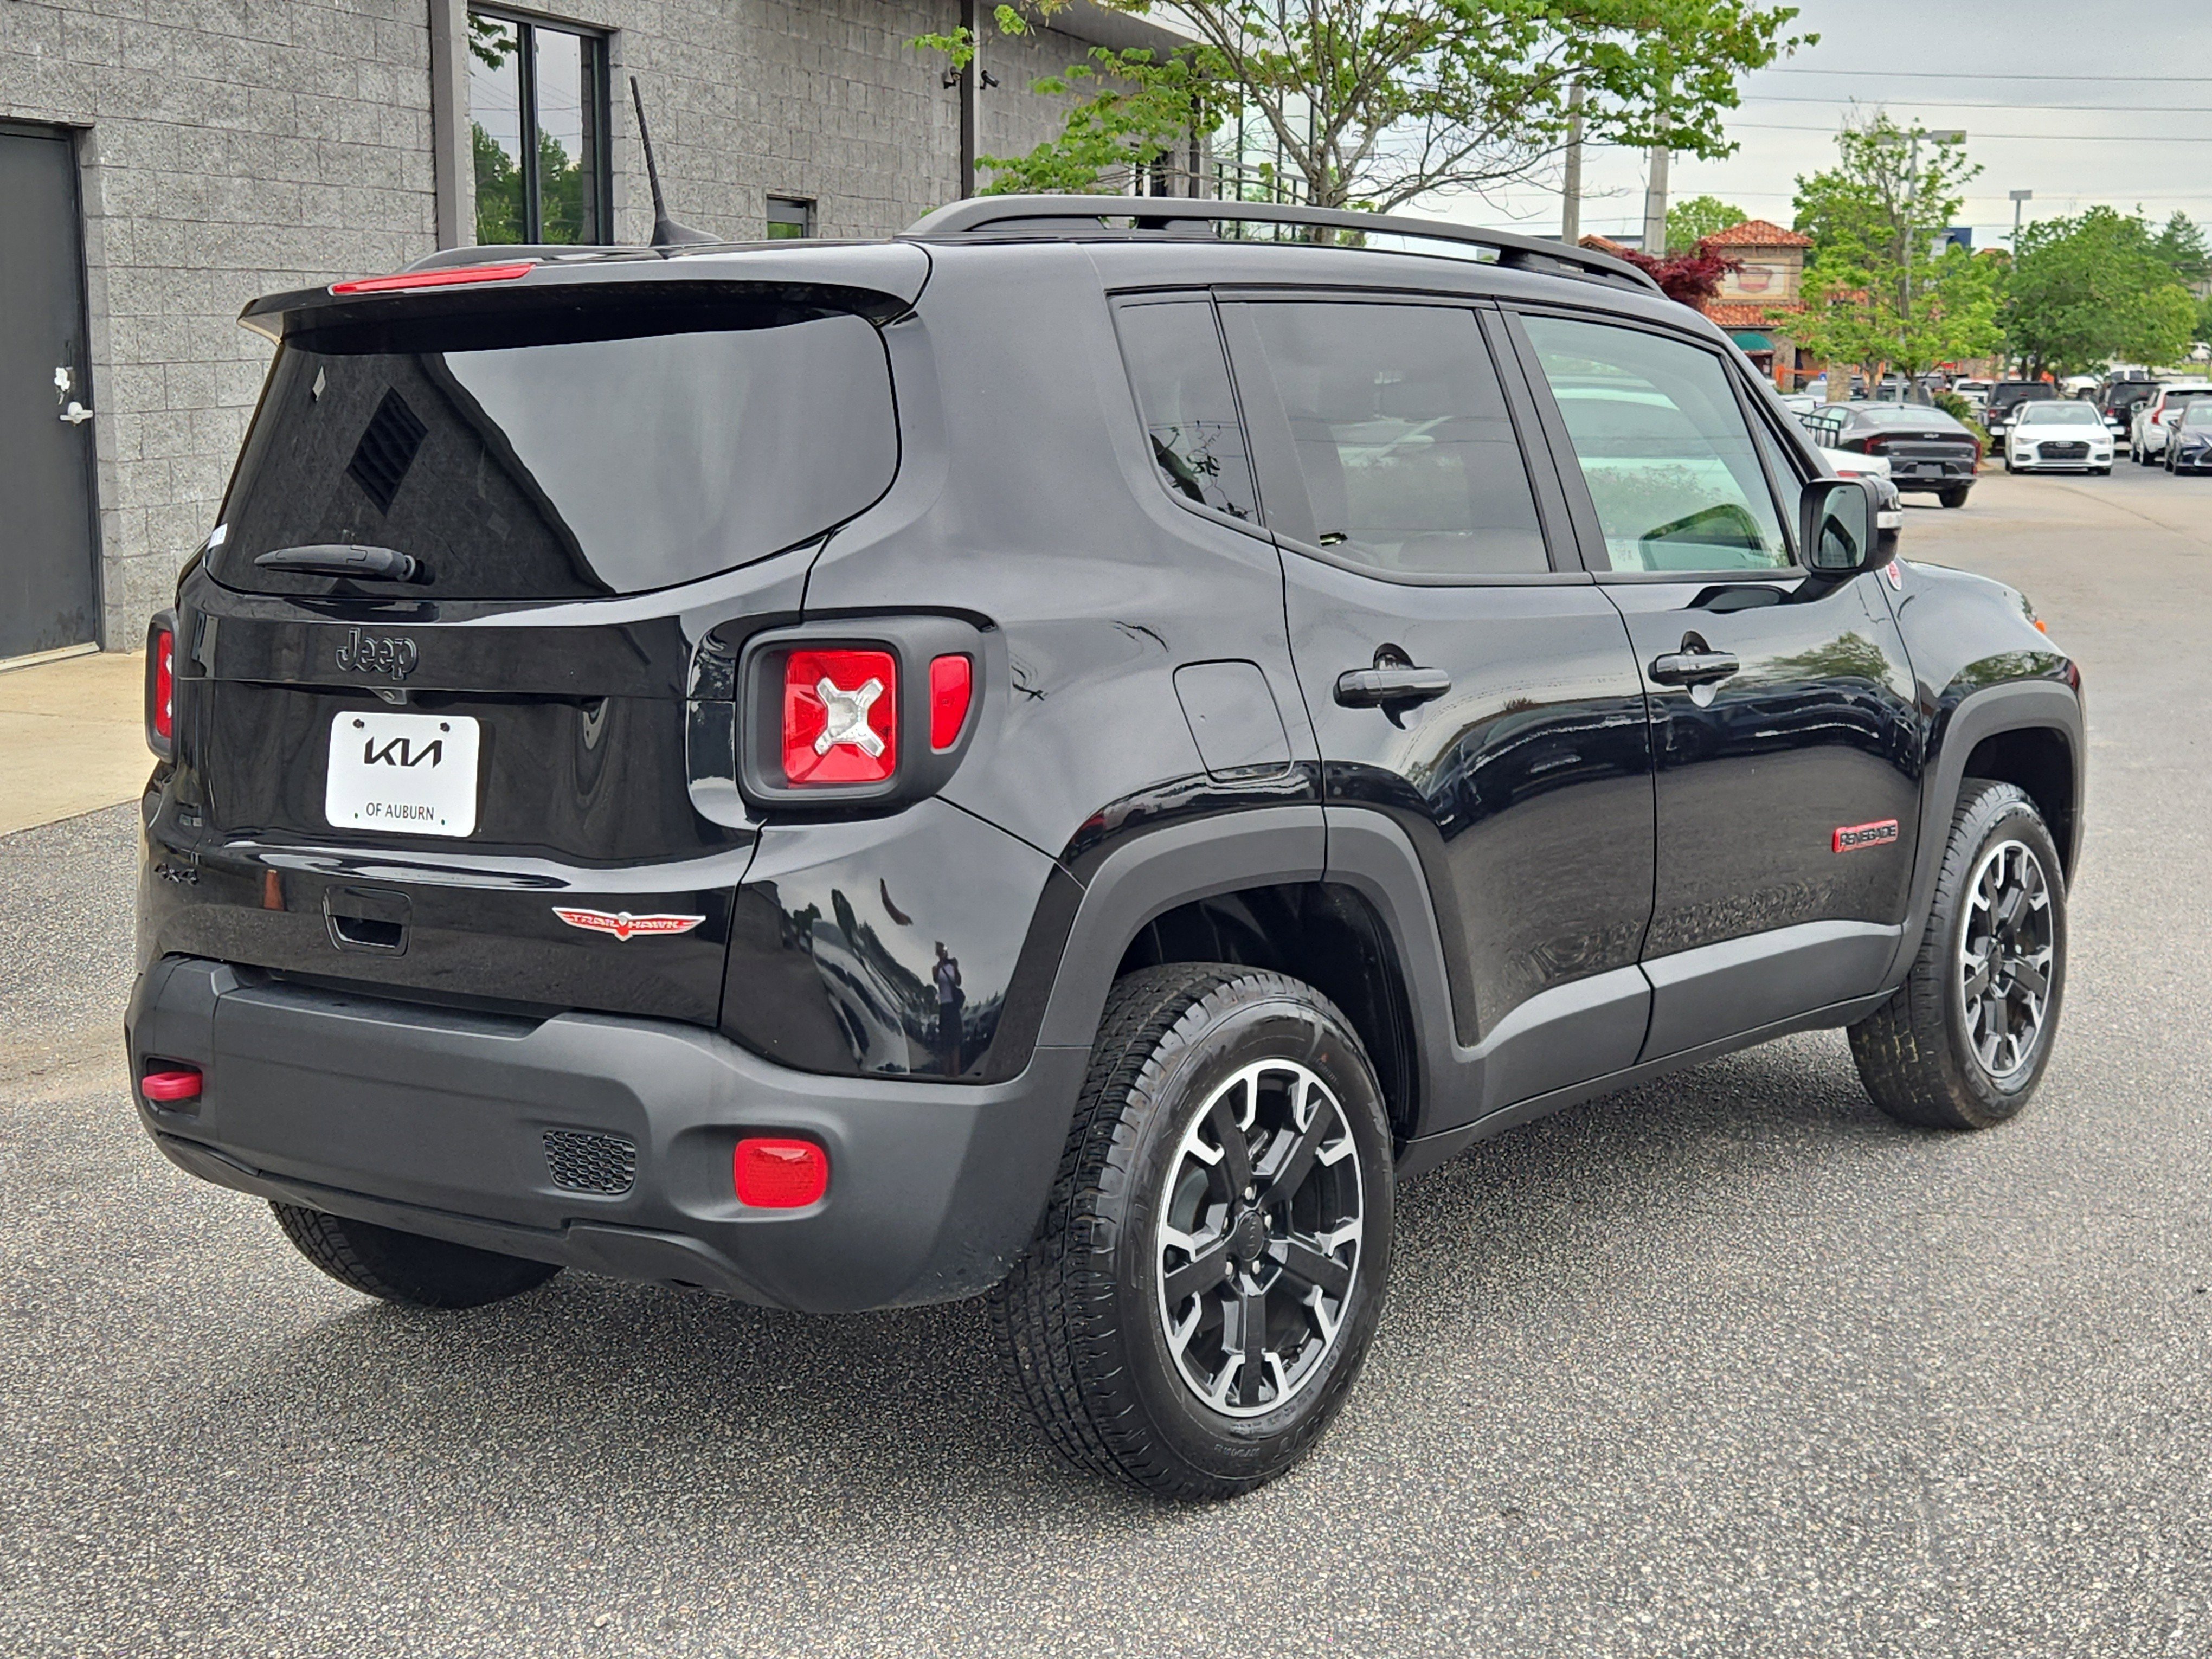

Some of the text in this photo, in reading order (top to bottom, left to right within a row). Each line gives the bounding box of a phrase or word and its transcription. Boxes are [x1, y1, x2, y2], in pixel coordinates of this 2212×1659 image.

[336, 627, 418, 680] Jeep
[364, 736, 443, 769] KIA
[366, 802, 434, 820] OF AUBURN
[1840, 822, 1896, 847] RENEGADE
